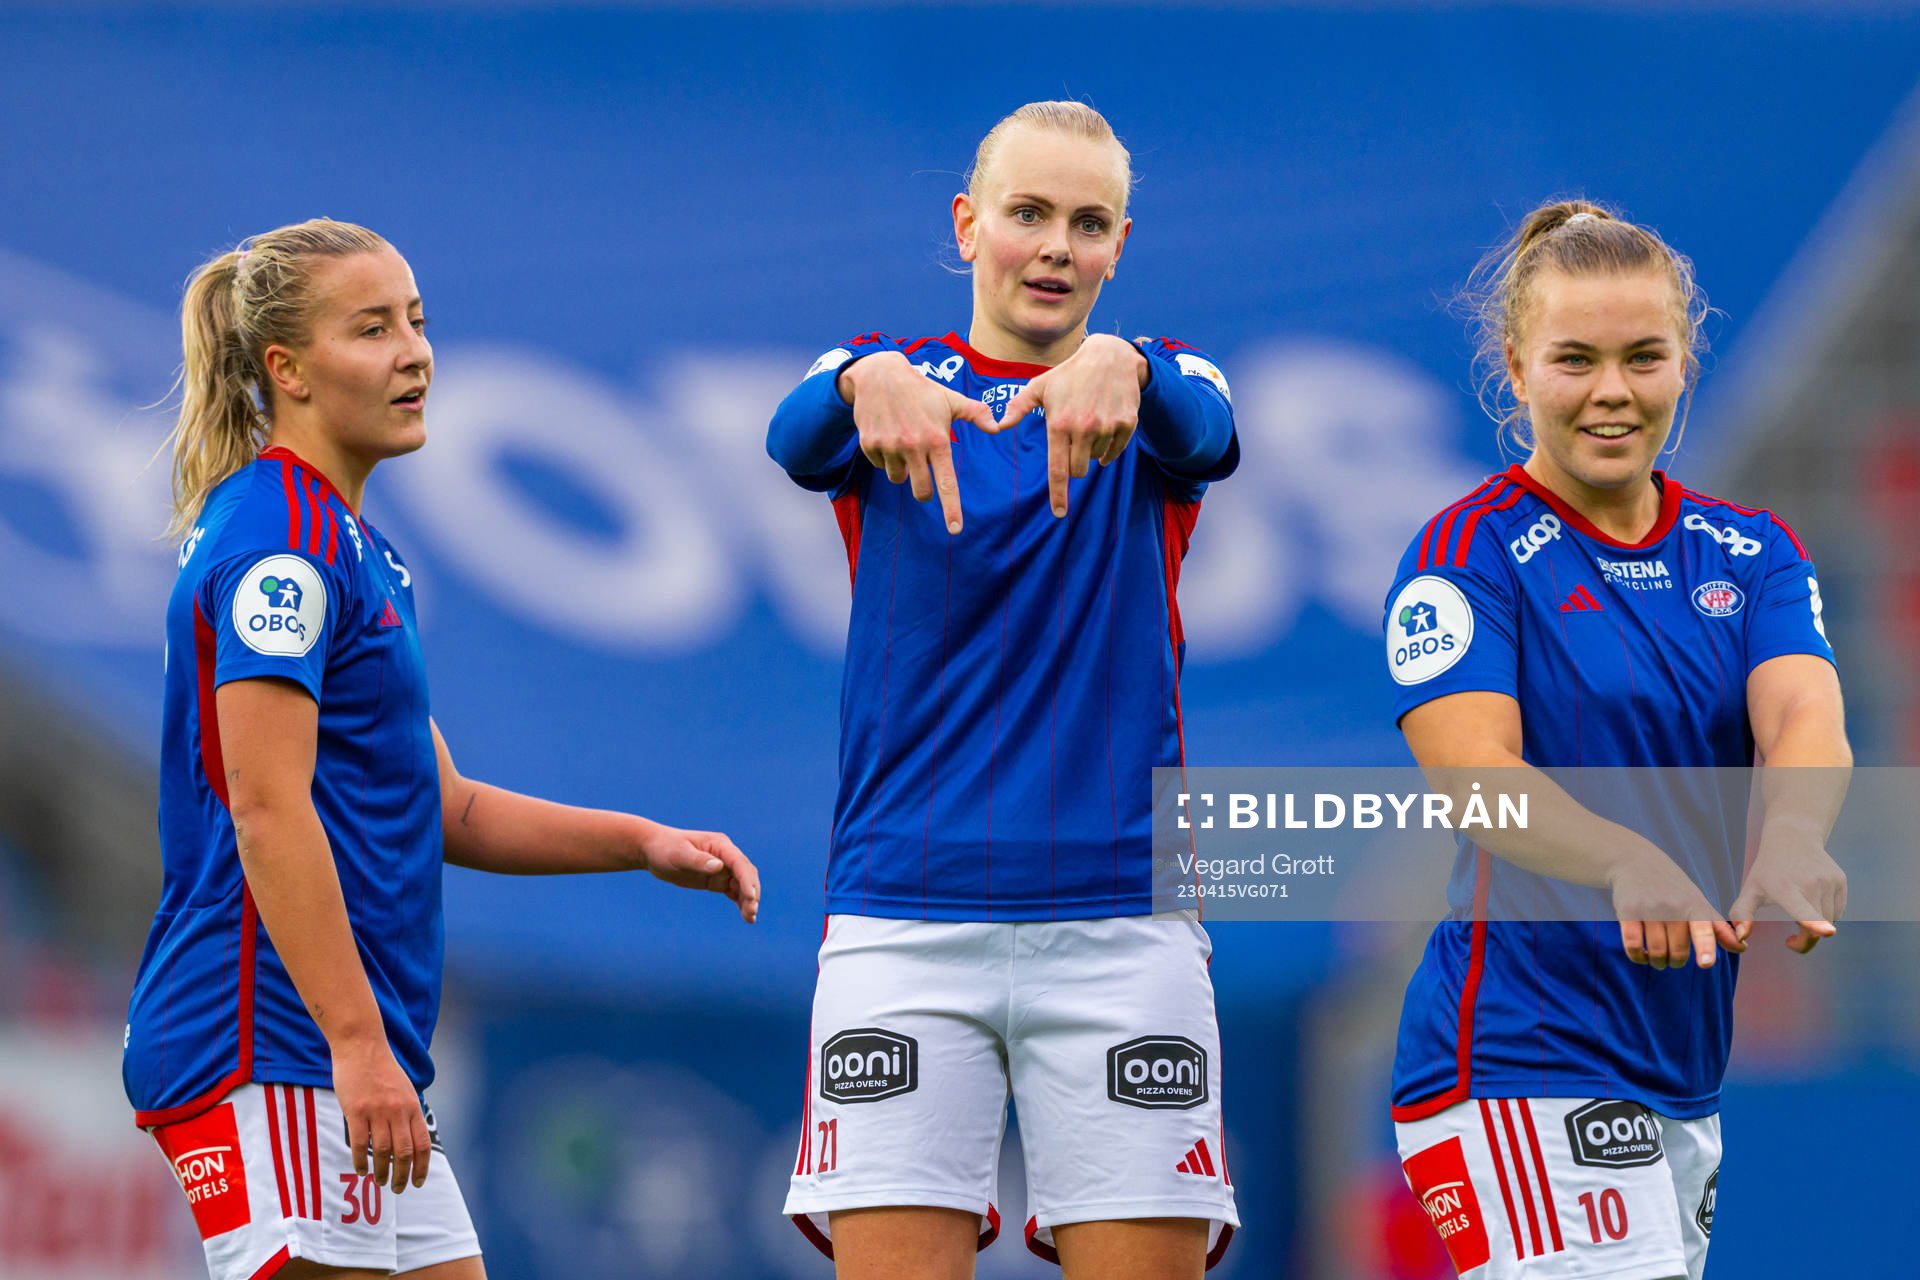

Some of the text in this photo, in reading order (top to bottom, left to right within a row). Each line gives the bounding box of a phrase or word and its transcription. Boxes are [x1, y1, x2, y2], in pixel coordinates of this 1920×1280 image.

[1612, 560, 1670, 580] STENA
[249, 613, 306, 642] OBOS
[1395, 633, 1455, 667] OBOS
[827, 1046, 901, 1079] ooni
[1123, 1056, 1199, 1086] ooni
[834, 1079, 888, 1091] PIZZA OVENS
[1136, 1087, 1193, 1097] PIZZA OVENS
[1585, 1113, 1656, 1146] ooni
[818, 1118, 838, 1173] 21
[1602, 1143, 1654, 1157] PIZZA OVENS
[187, 1177, 229, 1205] OTELS
[339, 1173, 382, 1226] 30
[1438, 1213, 1470, 1240] OTELS
[1578, 1187, 1628, 1243] 10
